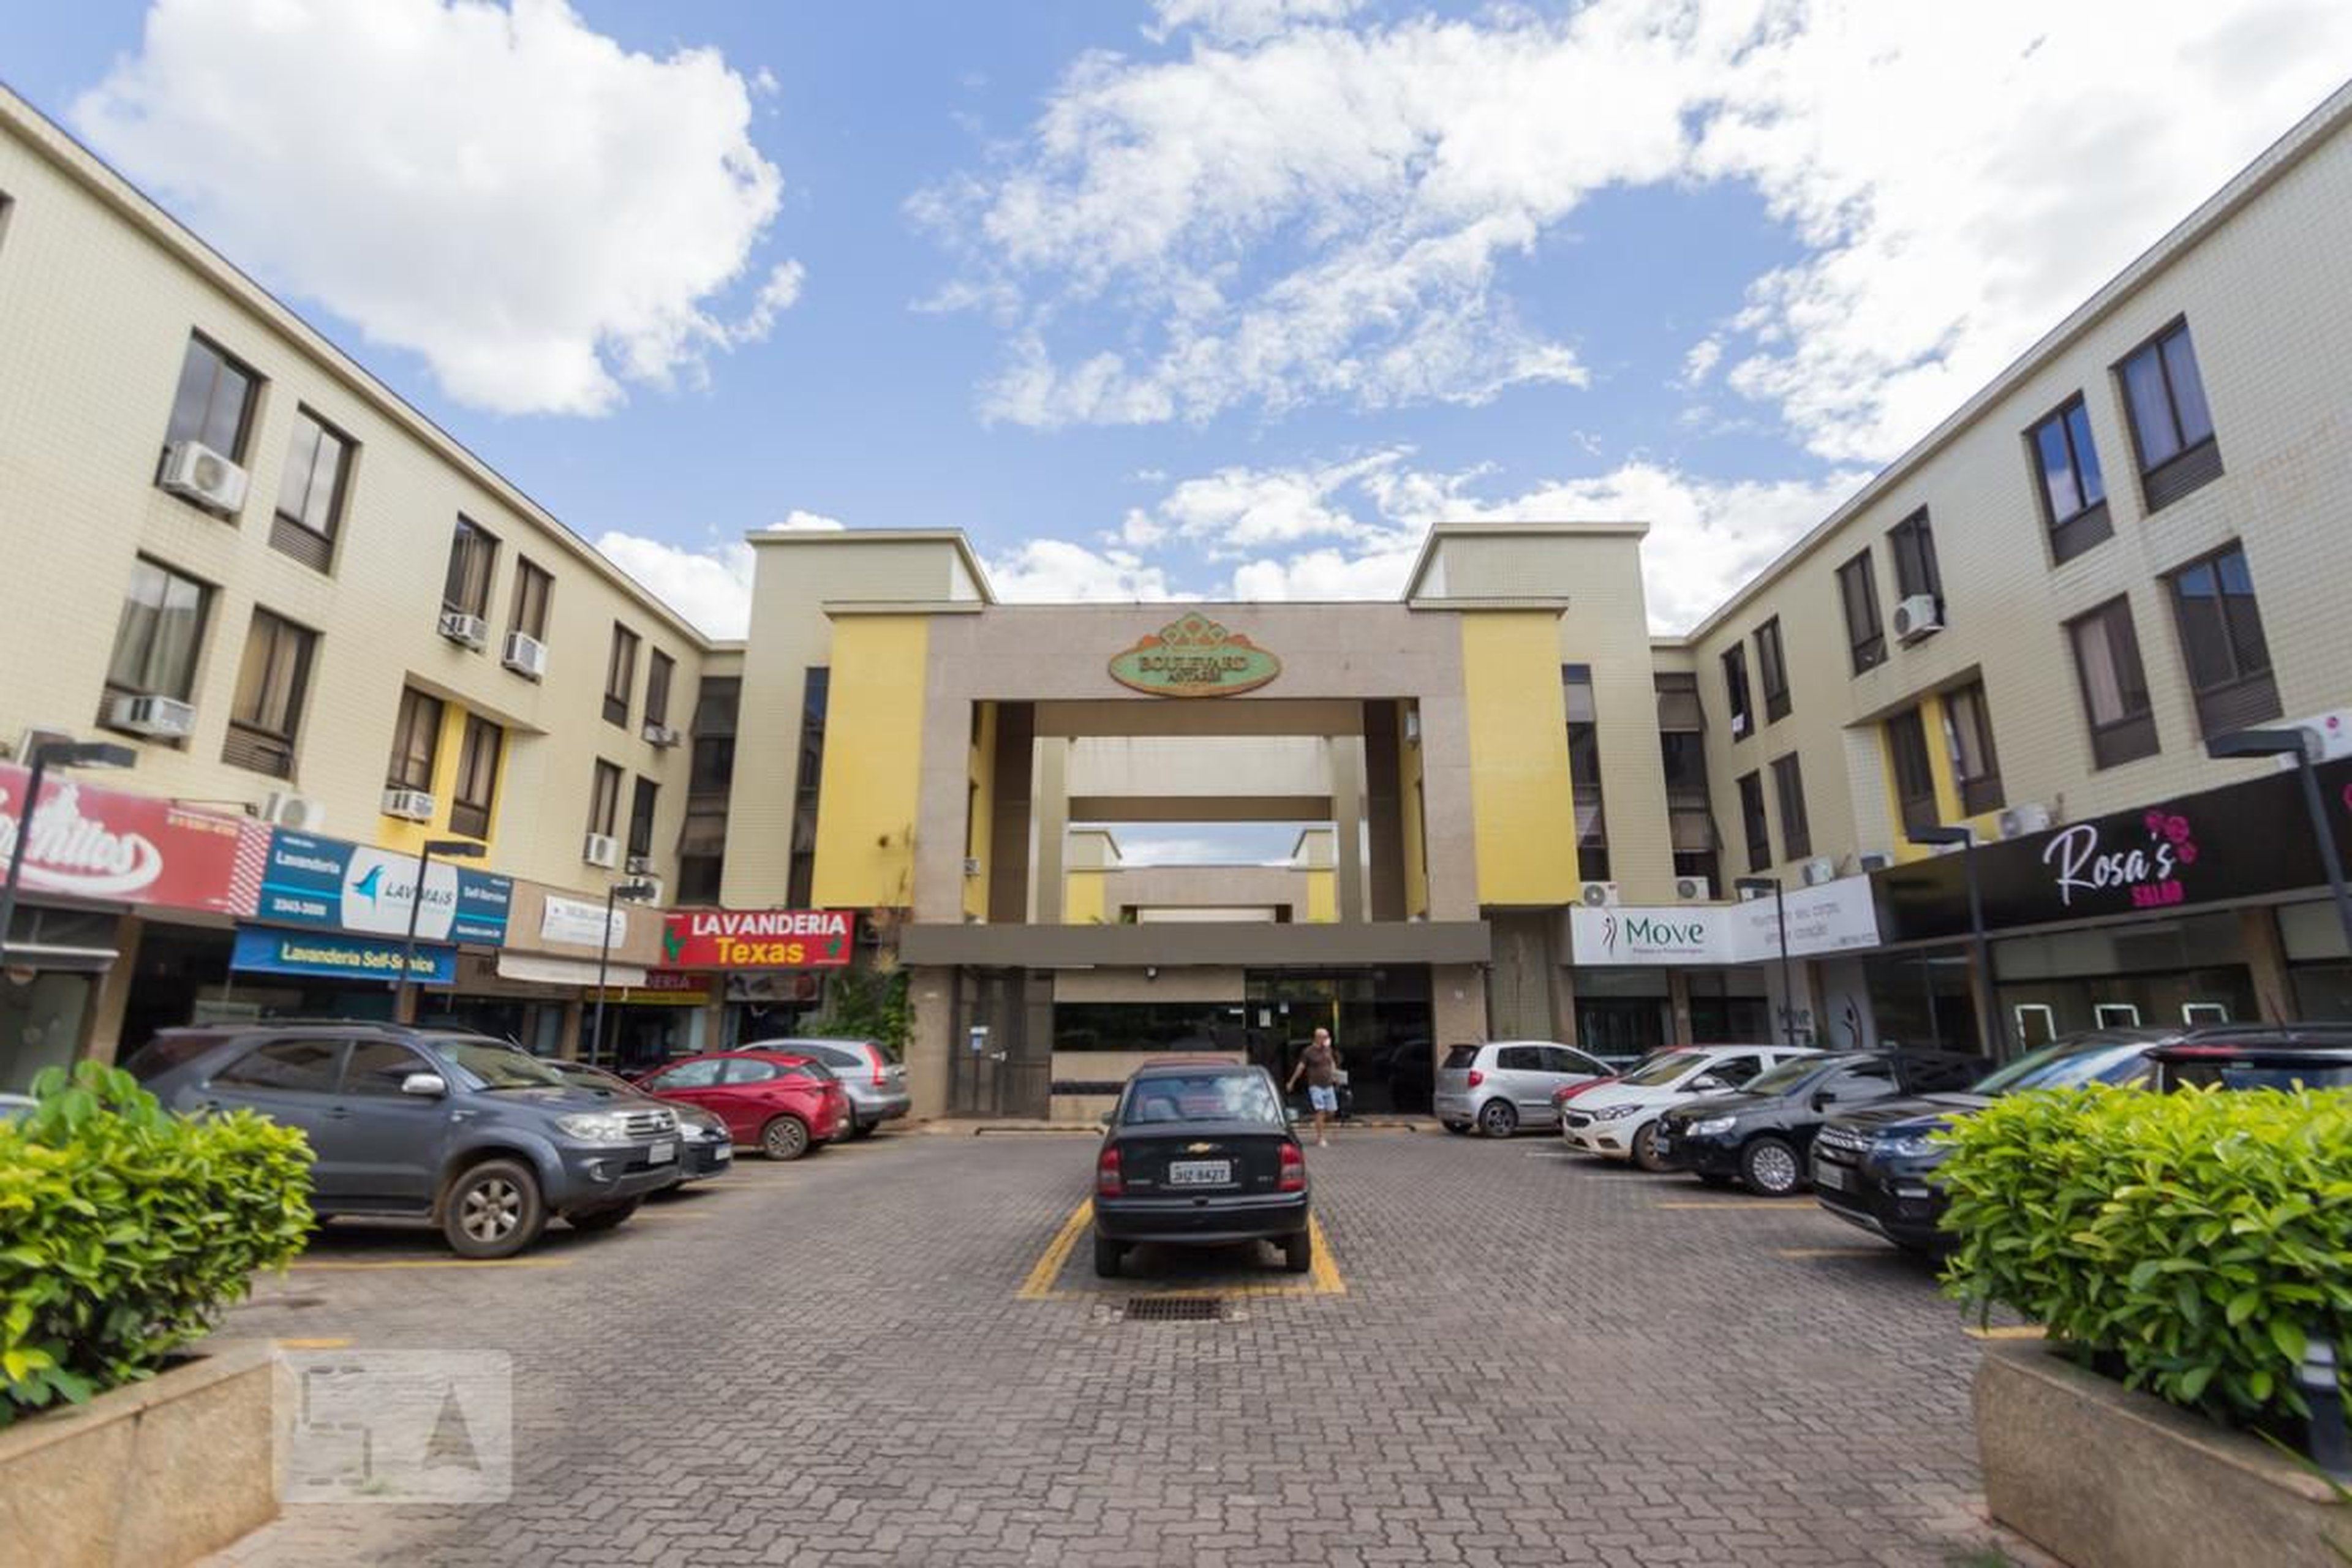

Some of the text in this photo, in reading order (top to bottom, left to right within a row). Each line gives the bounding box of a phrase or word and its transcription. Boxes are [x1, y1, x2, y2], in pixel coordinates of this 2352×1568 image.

[2043, 824, 2176, 906] Rosa's
[692, 914, 846, 935] LAVANDERIA
[1626, 918, 1704, 945] Move
[282, 942, 360, 967] Lavanderia
[715, 937, 805, 964] Texas
